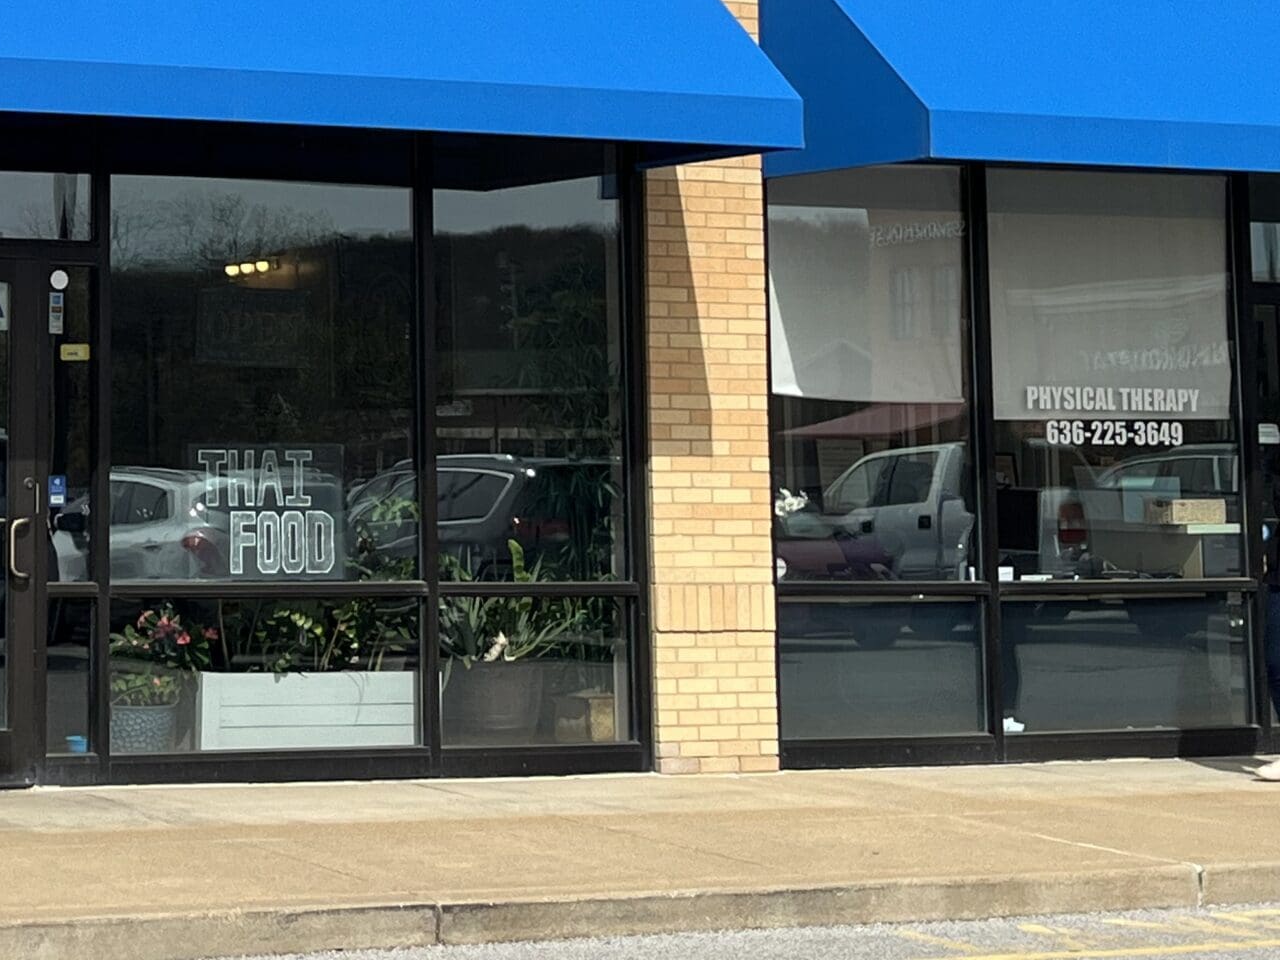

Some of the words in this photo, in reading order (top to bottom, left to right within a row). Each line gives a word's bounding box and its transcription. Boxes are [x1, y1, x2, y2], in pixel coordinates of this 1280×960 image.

[1026, 385, 1116, 411] PHYSICAL
[1119, 387, 1200, 413] THERAPY
[1046, 420, 1184, 447] 636-225-3649
[198, 449, 312, 507] THAI
[230, 510, 336, 575] FOOD
